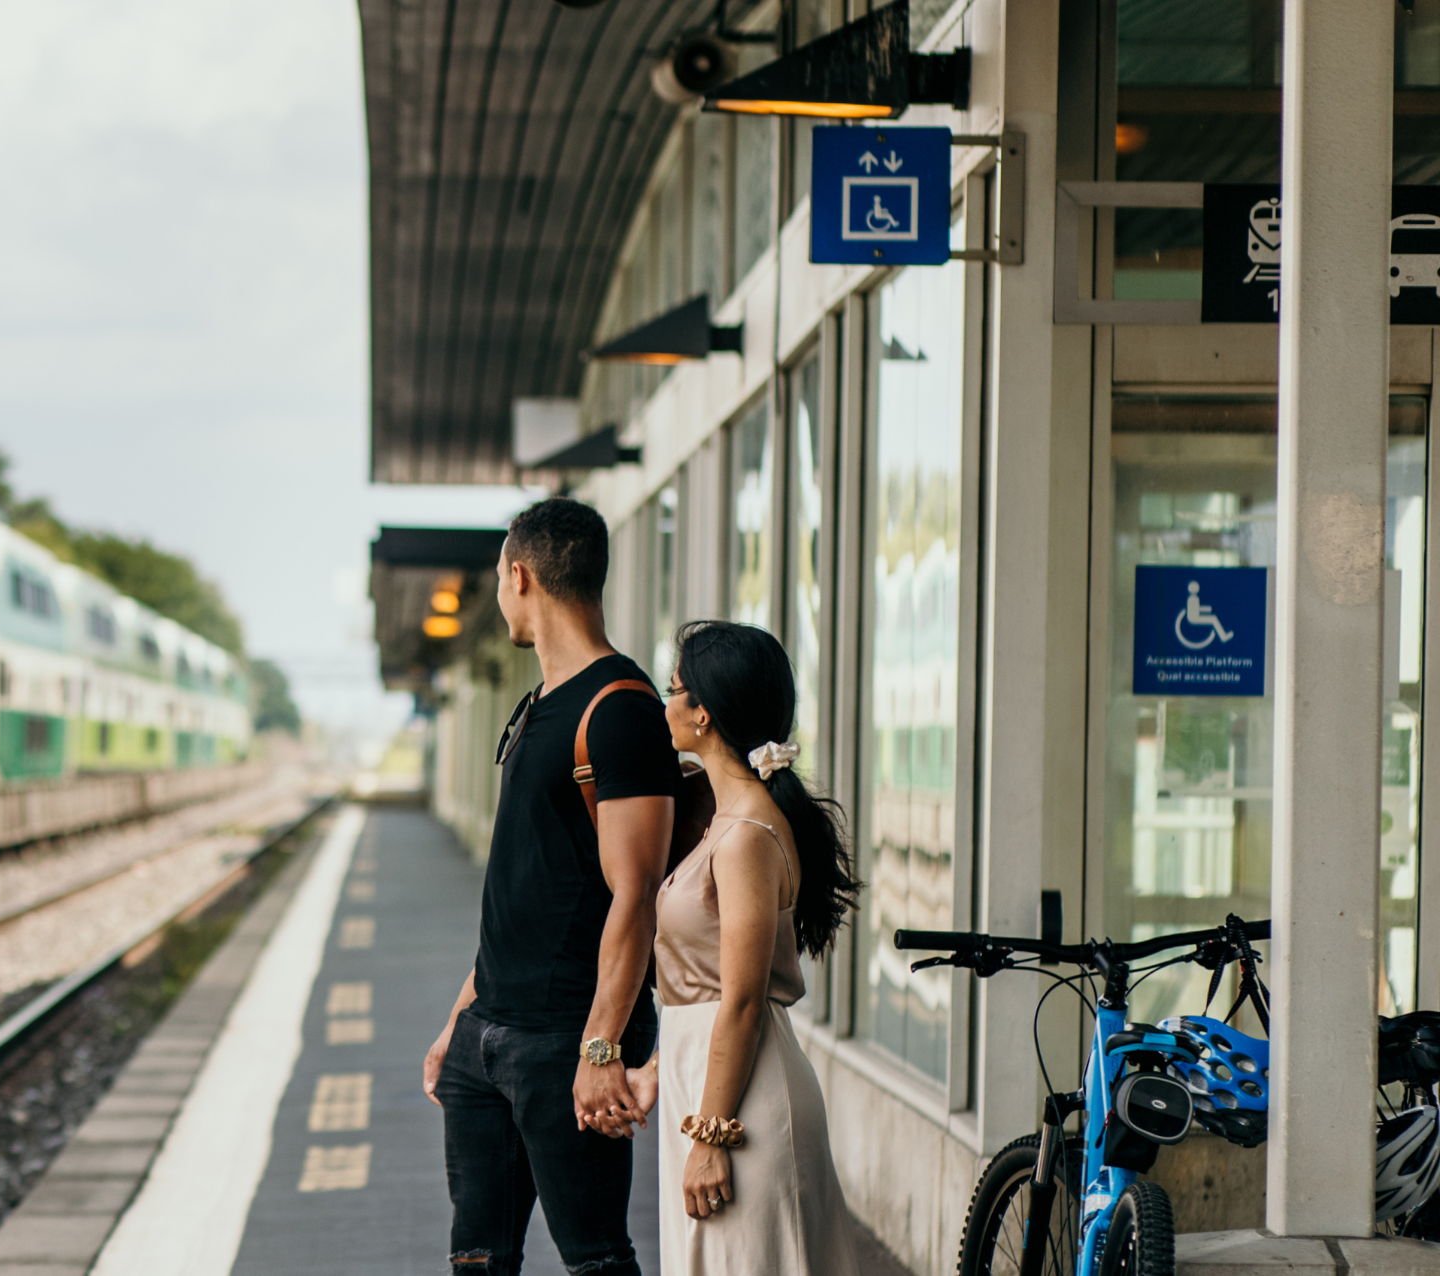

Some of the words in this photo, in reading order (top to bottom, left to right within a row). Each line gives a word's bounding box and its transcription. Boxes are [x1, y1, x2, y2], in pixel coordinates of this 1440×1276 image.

[1267, 288, 1279, 313] 1
[1146, 655, 1204, 667] Accessible
[1206, 656, 1253, 668] Platform
[1157, 670, 1182, 682] Quai
[1184, 672, 1241, 683] accessible
